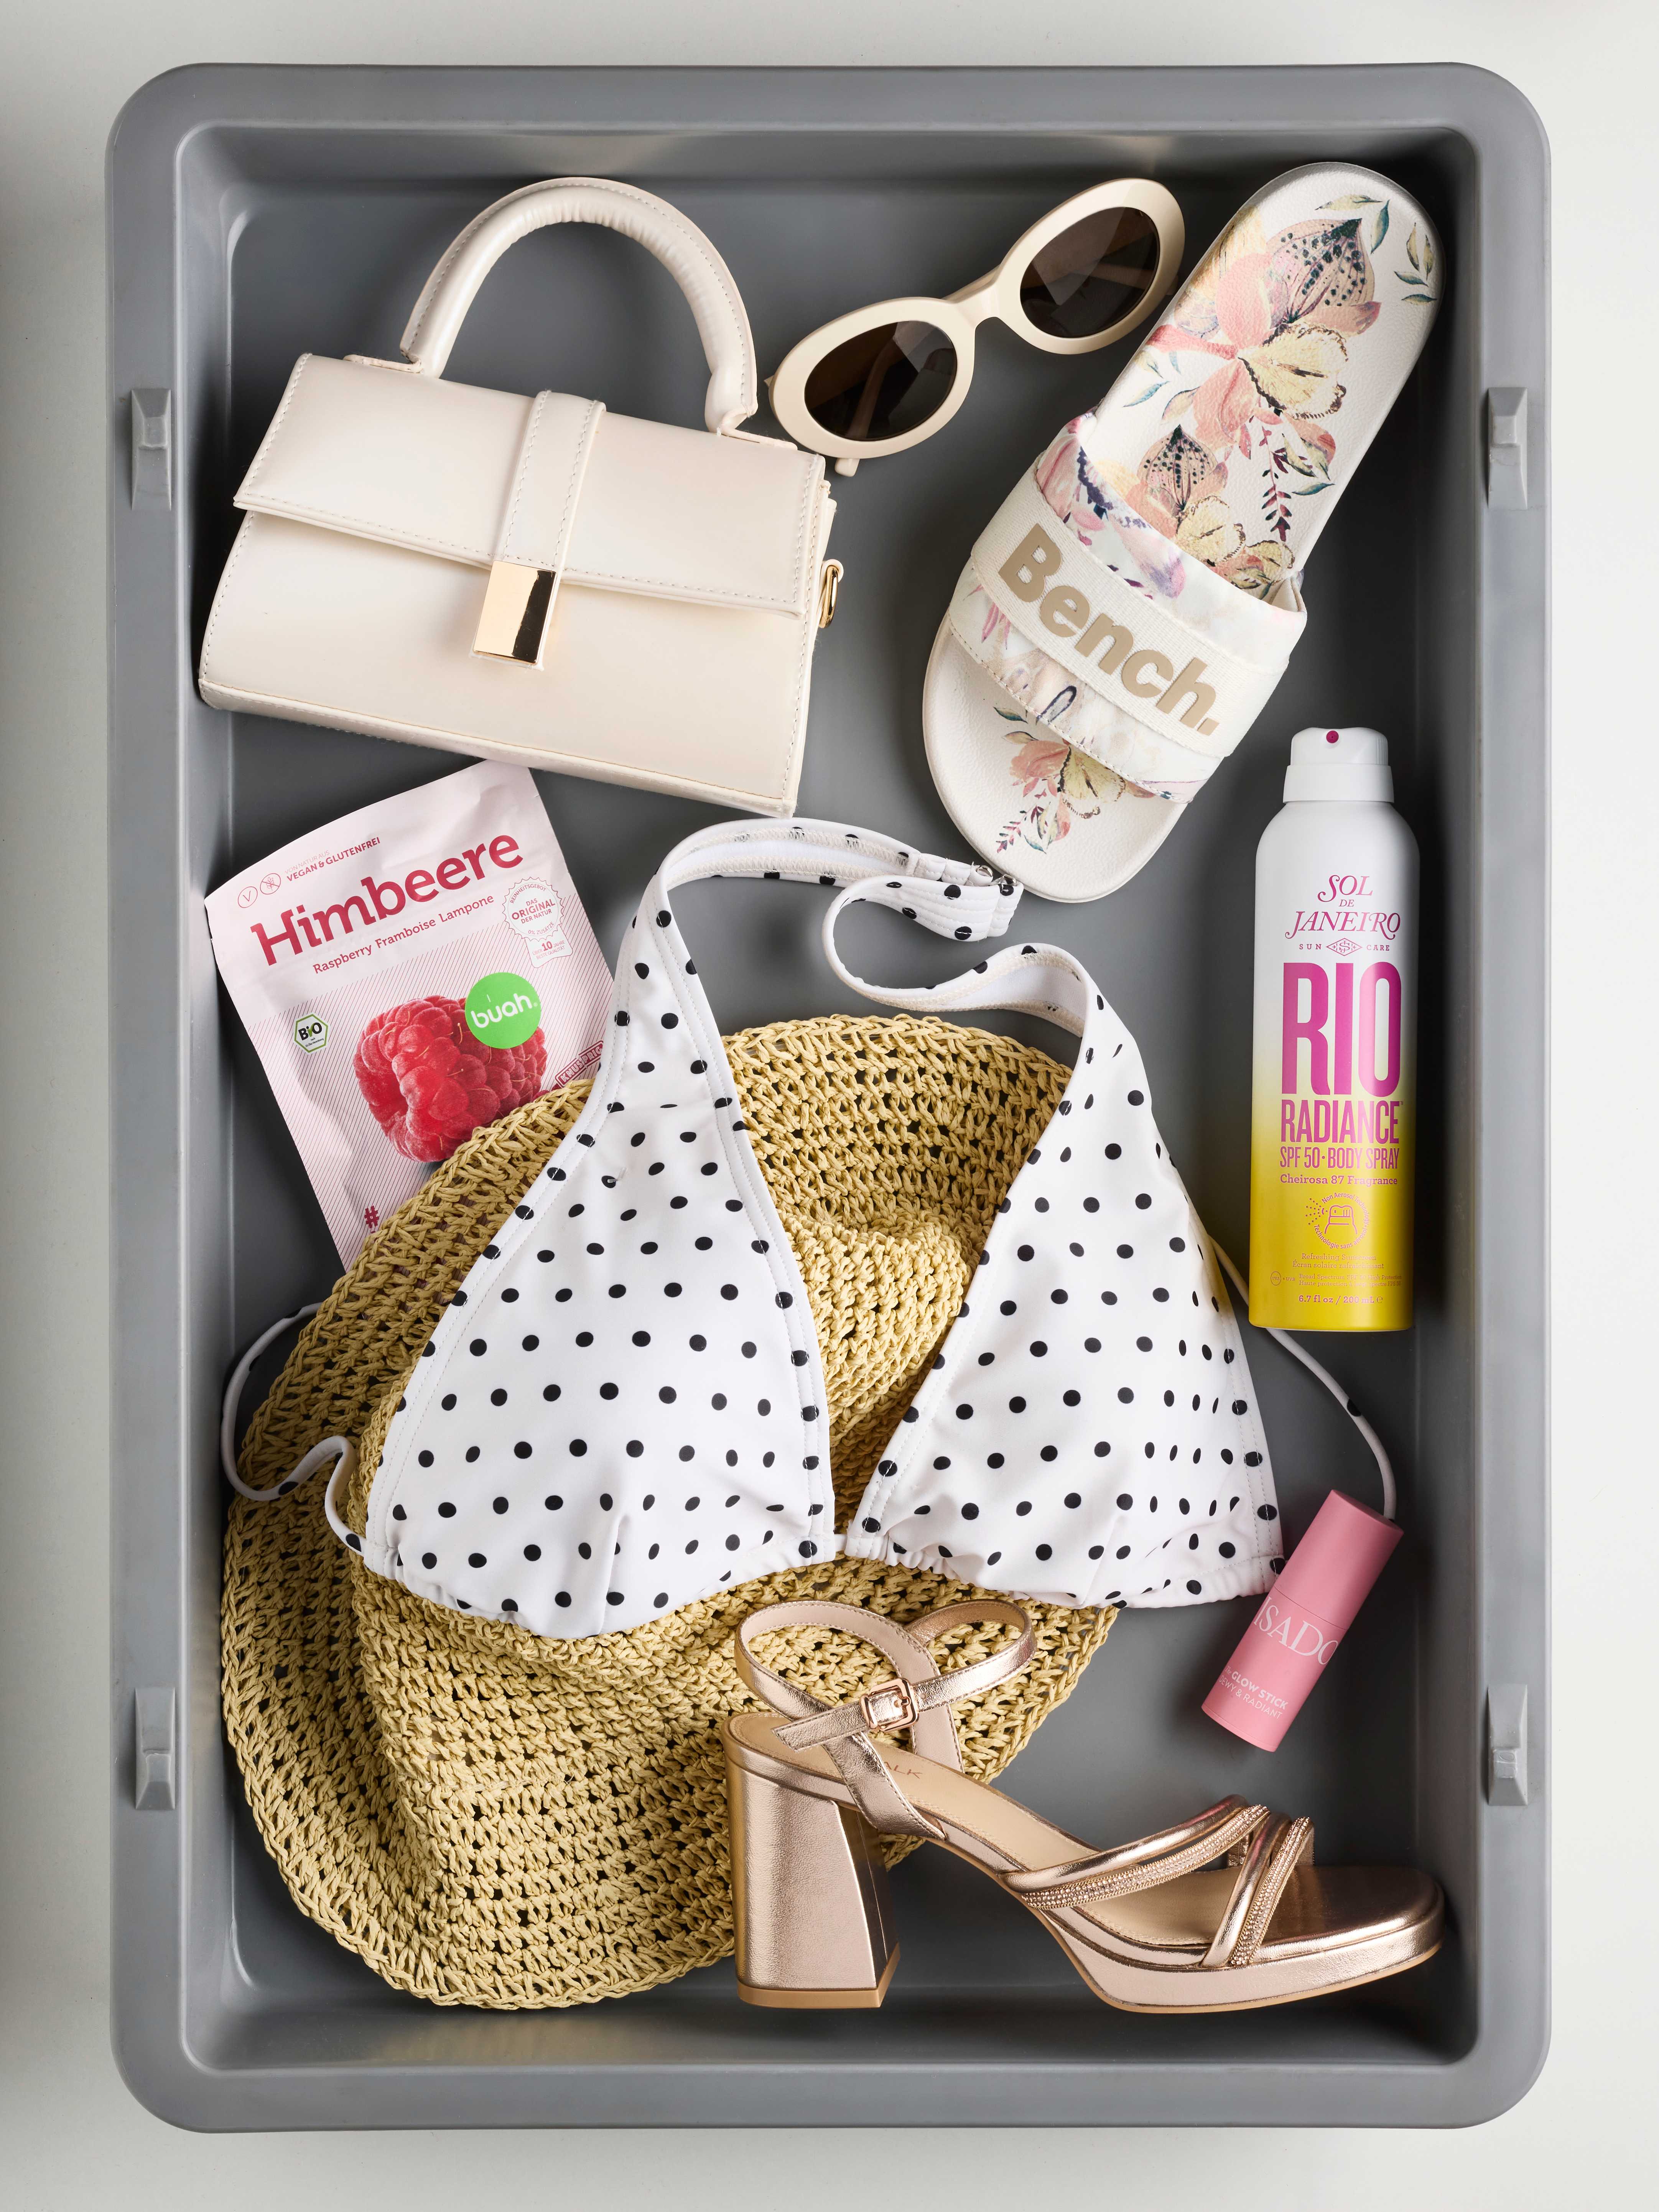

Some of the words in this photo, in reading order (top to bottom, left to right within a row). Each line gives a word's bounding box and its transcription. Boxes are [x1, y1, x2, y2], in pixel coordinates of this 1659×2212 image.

[998, 523, 1220, 736] Bench.
[285, 864, 298, 874] VON
[298, 855, 318, 868] NATUR
[318, 850, 330, 860] AUS
[286, 863, 318, 882] VEGAN
[326, 837, 380, 864] GLUTENFREI
[250, 835, 523, 966] Himbeere
[510, 884, 546, 903] REINHEITSGEBOT
[1318, 875, 1373, 902] SOL
[512, 899, 555, 919] ORIGINAL
[521, 916, 533, 924] DER
[534, 909, 552, 919] NATUR
[313, 943, 372, 974] Raspberry
[375, 918, 436, 948] Framboise
[438, 895, 494, 922] Lampone
[1285, 911, 1400, 940] JANEIRO
[541, 941, 553, 951] 10
[1282, 962, 1401, 1097] RIO
[560, 1046, 602, 1082] KNUSPRIG
[1280, 1146, 1301, 1168] SPF
[1304, 1147, 1320, 1168] 50
[1328, 1148, 1363, 1168] BODY
[1366, 1148, 1399, 1169] SPRAY
[1280, 1174, 1328, 1184] Cheirosa
[1331, 1176, 1344, 1184] 87
[1348, 1176, 1397, 1187] Fragrance
[1322, 1195, 1333, 1204] Non
[1314, 1224, 1339, 1248] Technologie
[1292, 1260, 1312, 1268] Écran
[1335, 1296, 1341, 1305] /
[1219, 1675, 1237, 1692] DEWY
[1236, 1689, 1242, 1697] &
[1243, 1693, 1283, 1719] RADIANT
[1231, 1671, 1259, 1692] GLOW
[1258, 1689, 1288, 1710] STICK
